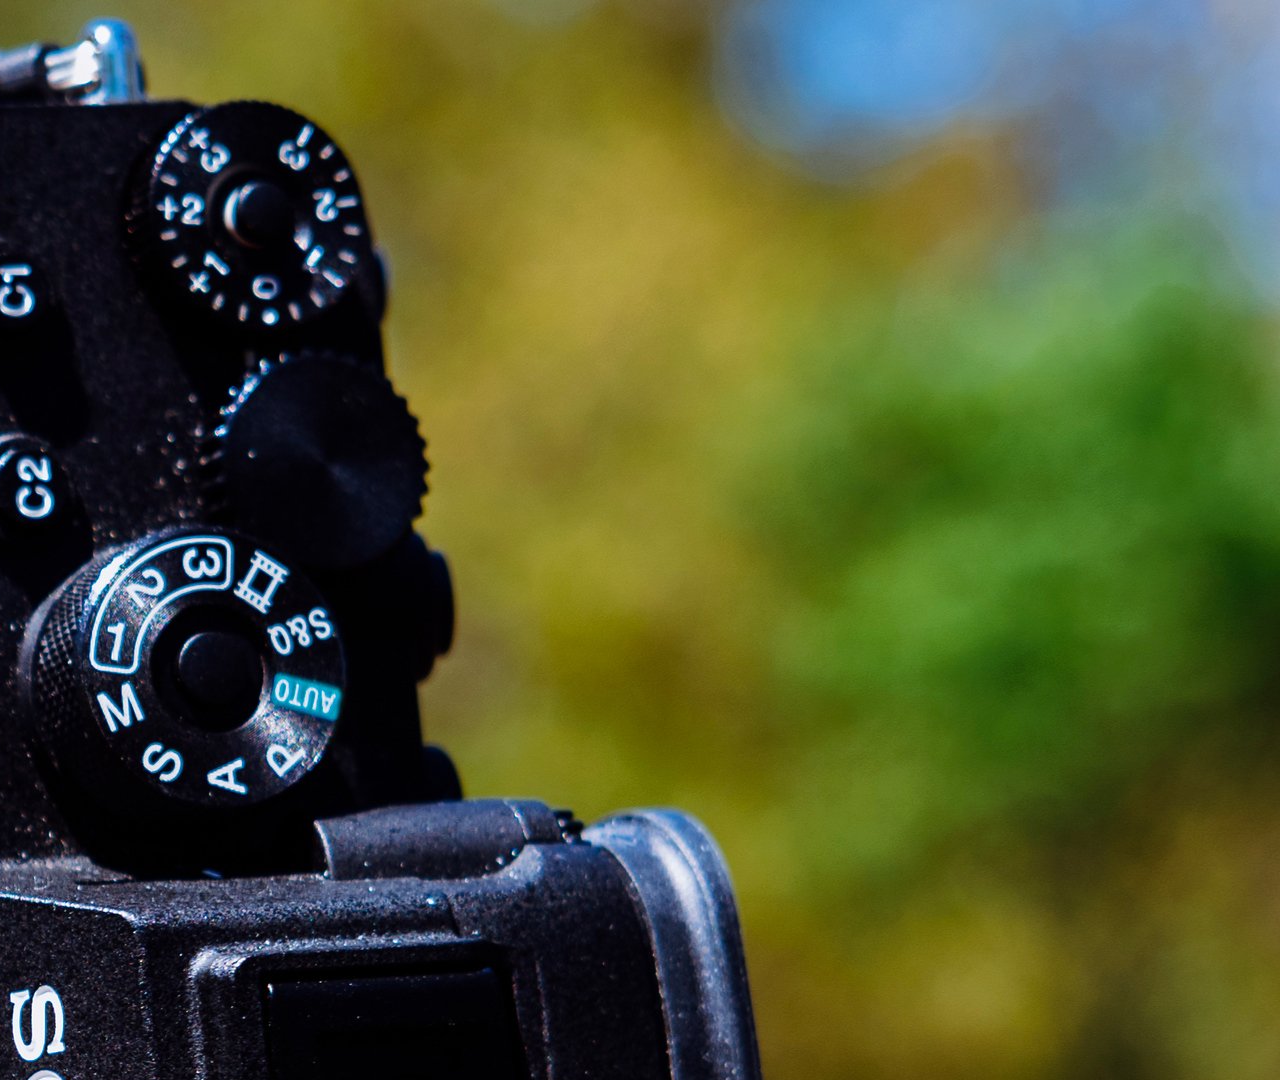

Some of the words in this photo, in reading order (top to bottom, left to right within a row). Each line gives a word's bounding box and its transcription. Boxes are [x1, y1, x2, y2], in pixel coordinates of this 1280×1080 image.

[185, 121, 231, 173] +3
[156, 193, 205, 226] +2
[15, 457, 55, 518] C2
[182, 547, 223, 579] 3
[123, 564, 169, 610] 2
[106, 618, 127, 662] 1
[264, 603, 334, 656] S&Q
[96, 680, 145, 733] M
[274, 678, 337, 714] AUTO
[142, 742, 184, 783] S
[206, 757, 248, 795] A
[266, 737, 308, 778] P
